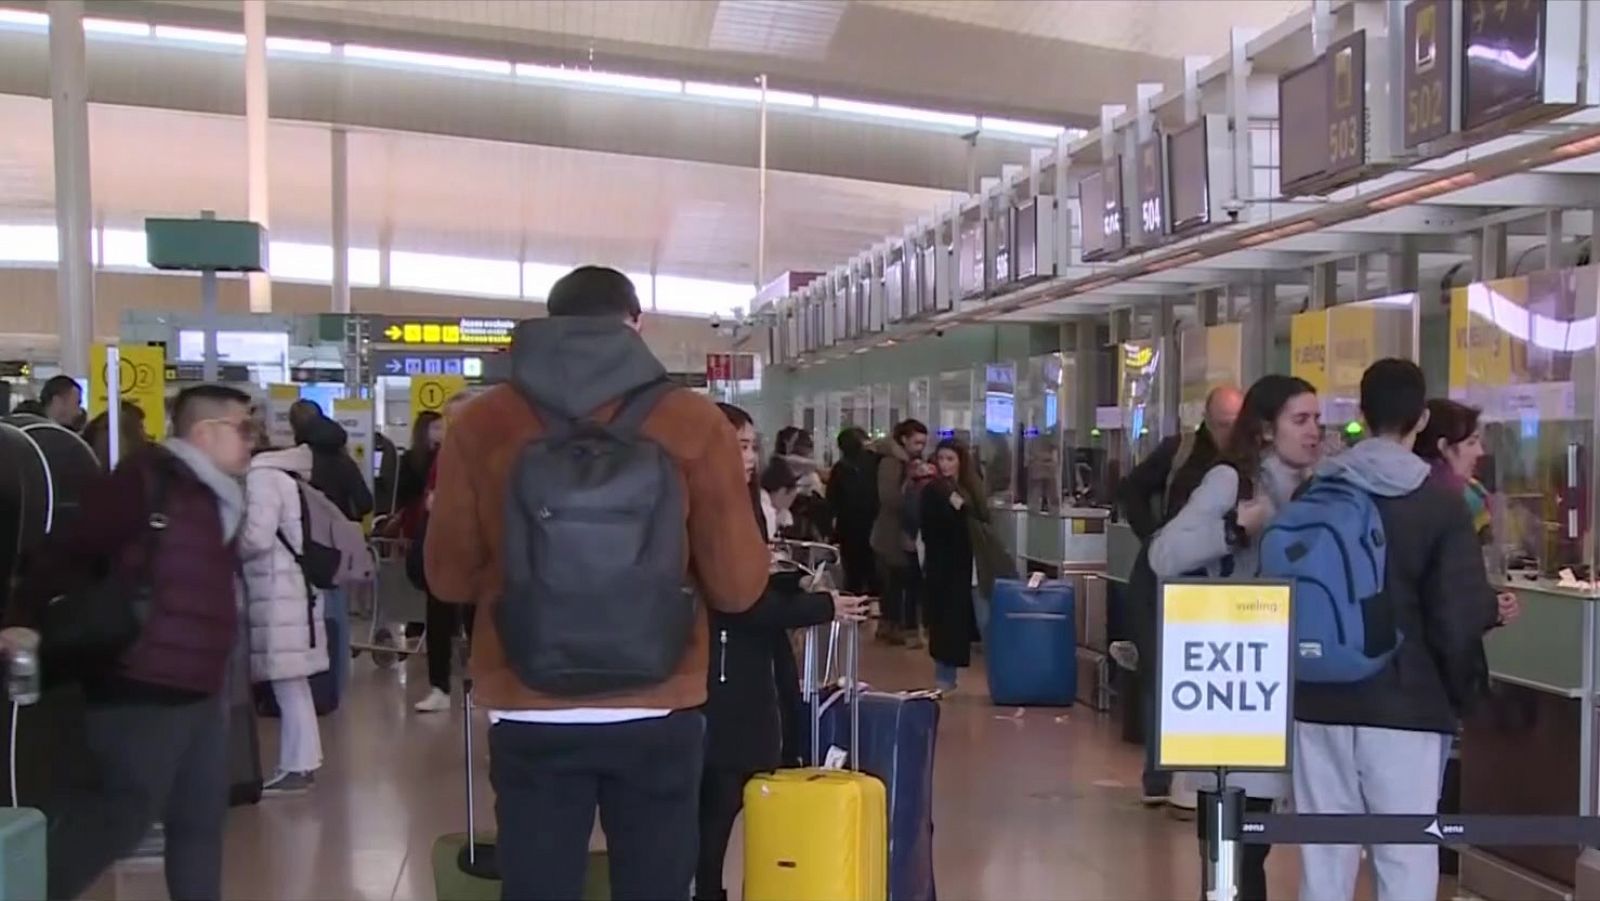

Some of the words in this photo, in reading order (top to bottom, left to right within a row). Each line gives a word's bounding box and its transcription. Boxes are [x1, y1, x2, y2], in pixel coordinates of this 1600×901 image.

[1408, 80, 1442, 134] 502
[1330, 115, 1357, 163] 503
[1142, 197, 1161, 232] 504
[139, 368, 148, 385] 2
[1236, 599, 1279, 612] vueling
[1184, 641, 1269, 672] EXIT
[1171, 680, 1281, 711] ONLY
[1442, 825, 1464, 834] aena
